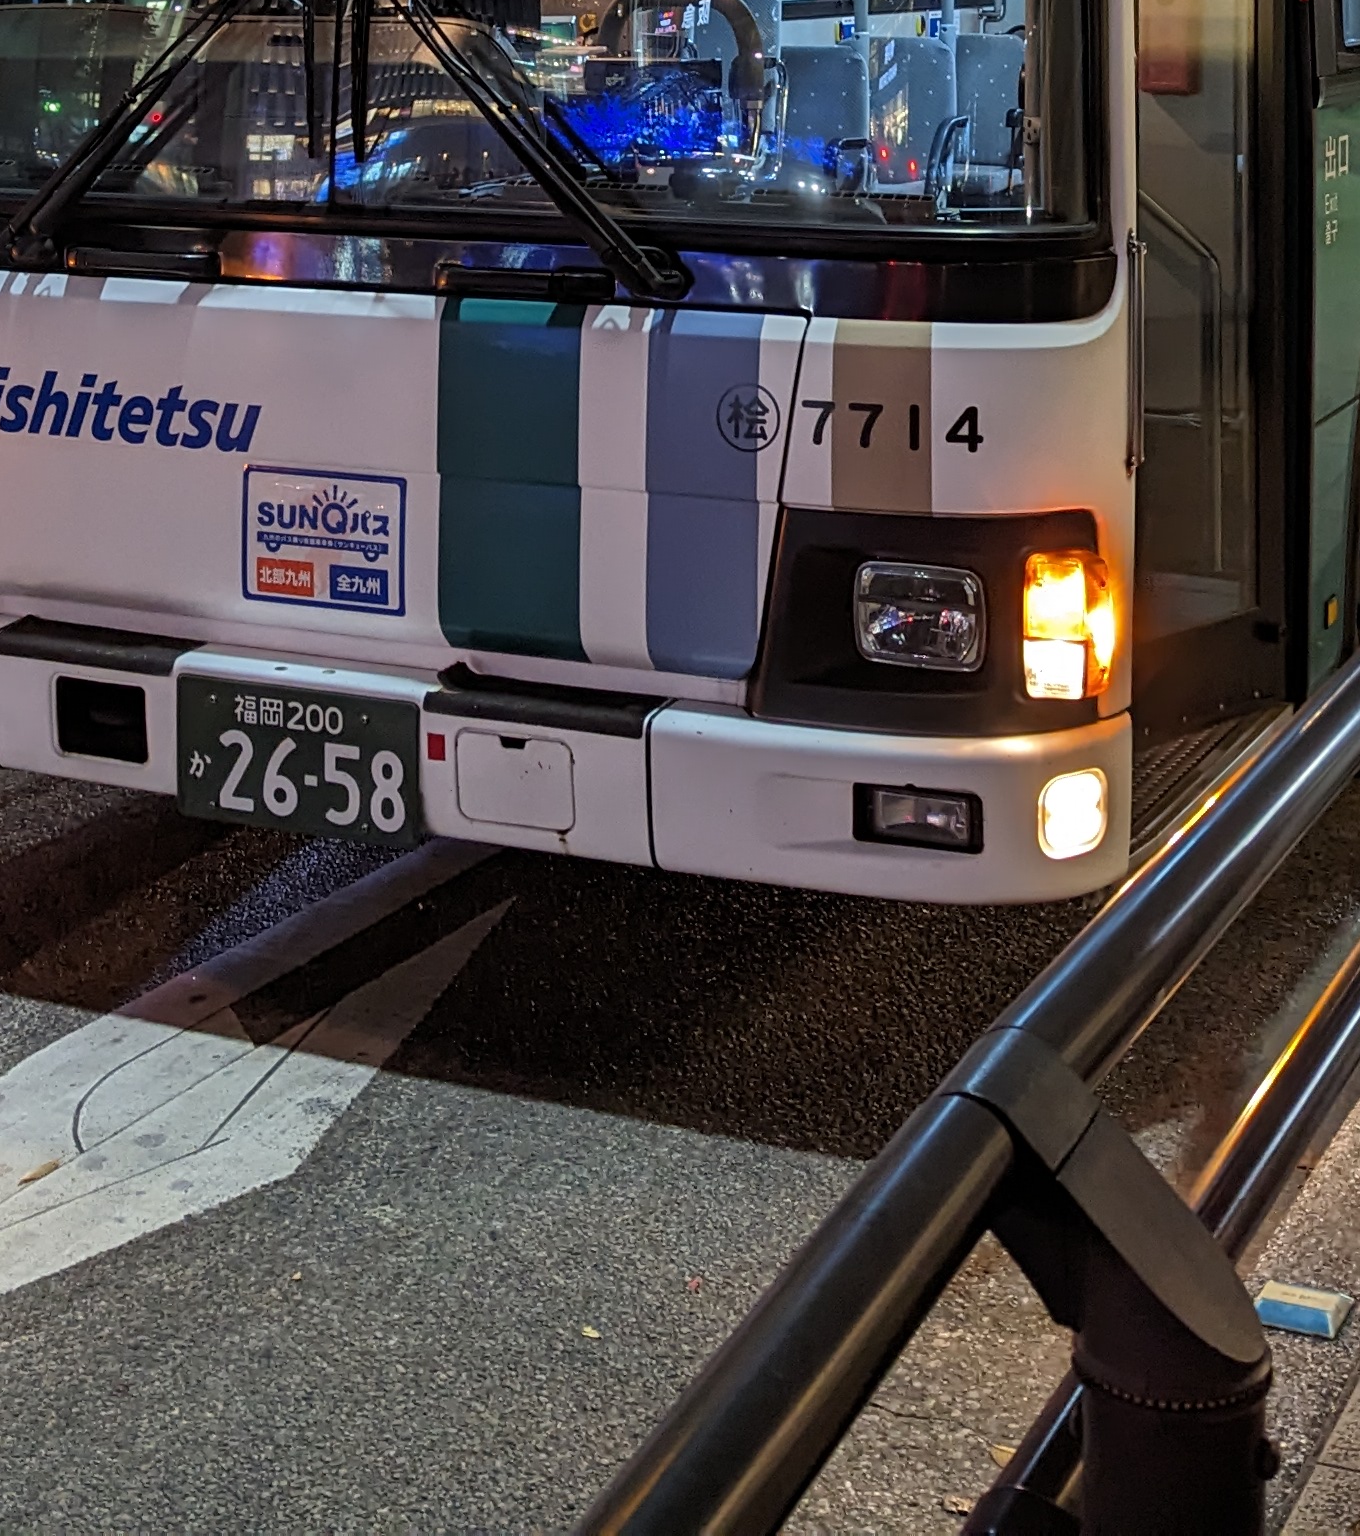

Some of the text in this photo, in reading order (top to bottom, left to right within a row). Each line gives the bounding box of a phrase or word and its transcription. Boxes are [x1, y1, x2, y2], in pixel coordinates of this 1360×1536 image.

[1324, 134, 1349, 182] 出口
[722, 389, 984, 453] 桧 7714
[257, 500, 390, 538] SUNQパス
[259, 566, 312, 588] 北部九州
[336, 573, 382, 596] 全九州
[189, 728, 406, 833] か 26-58
